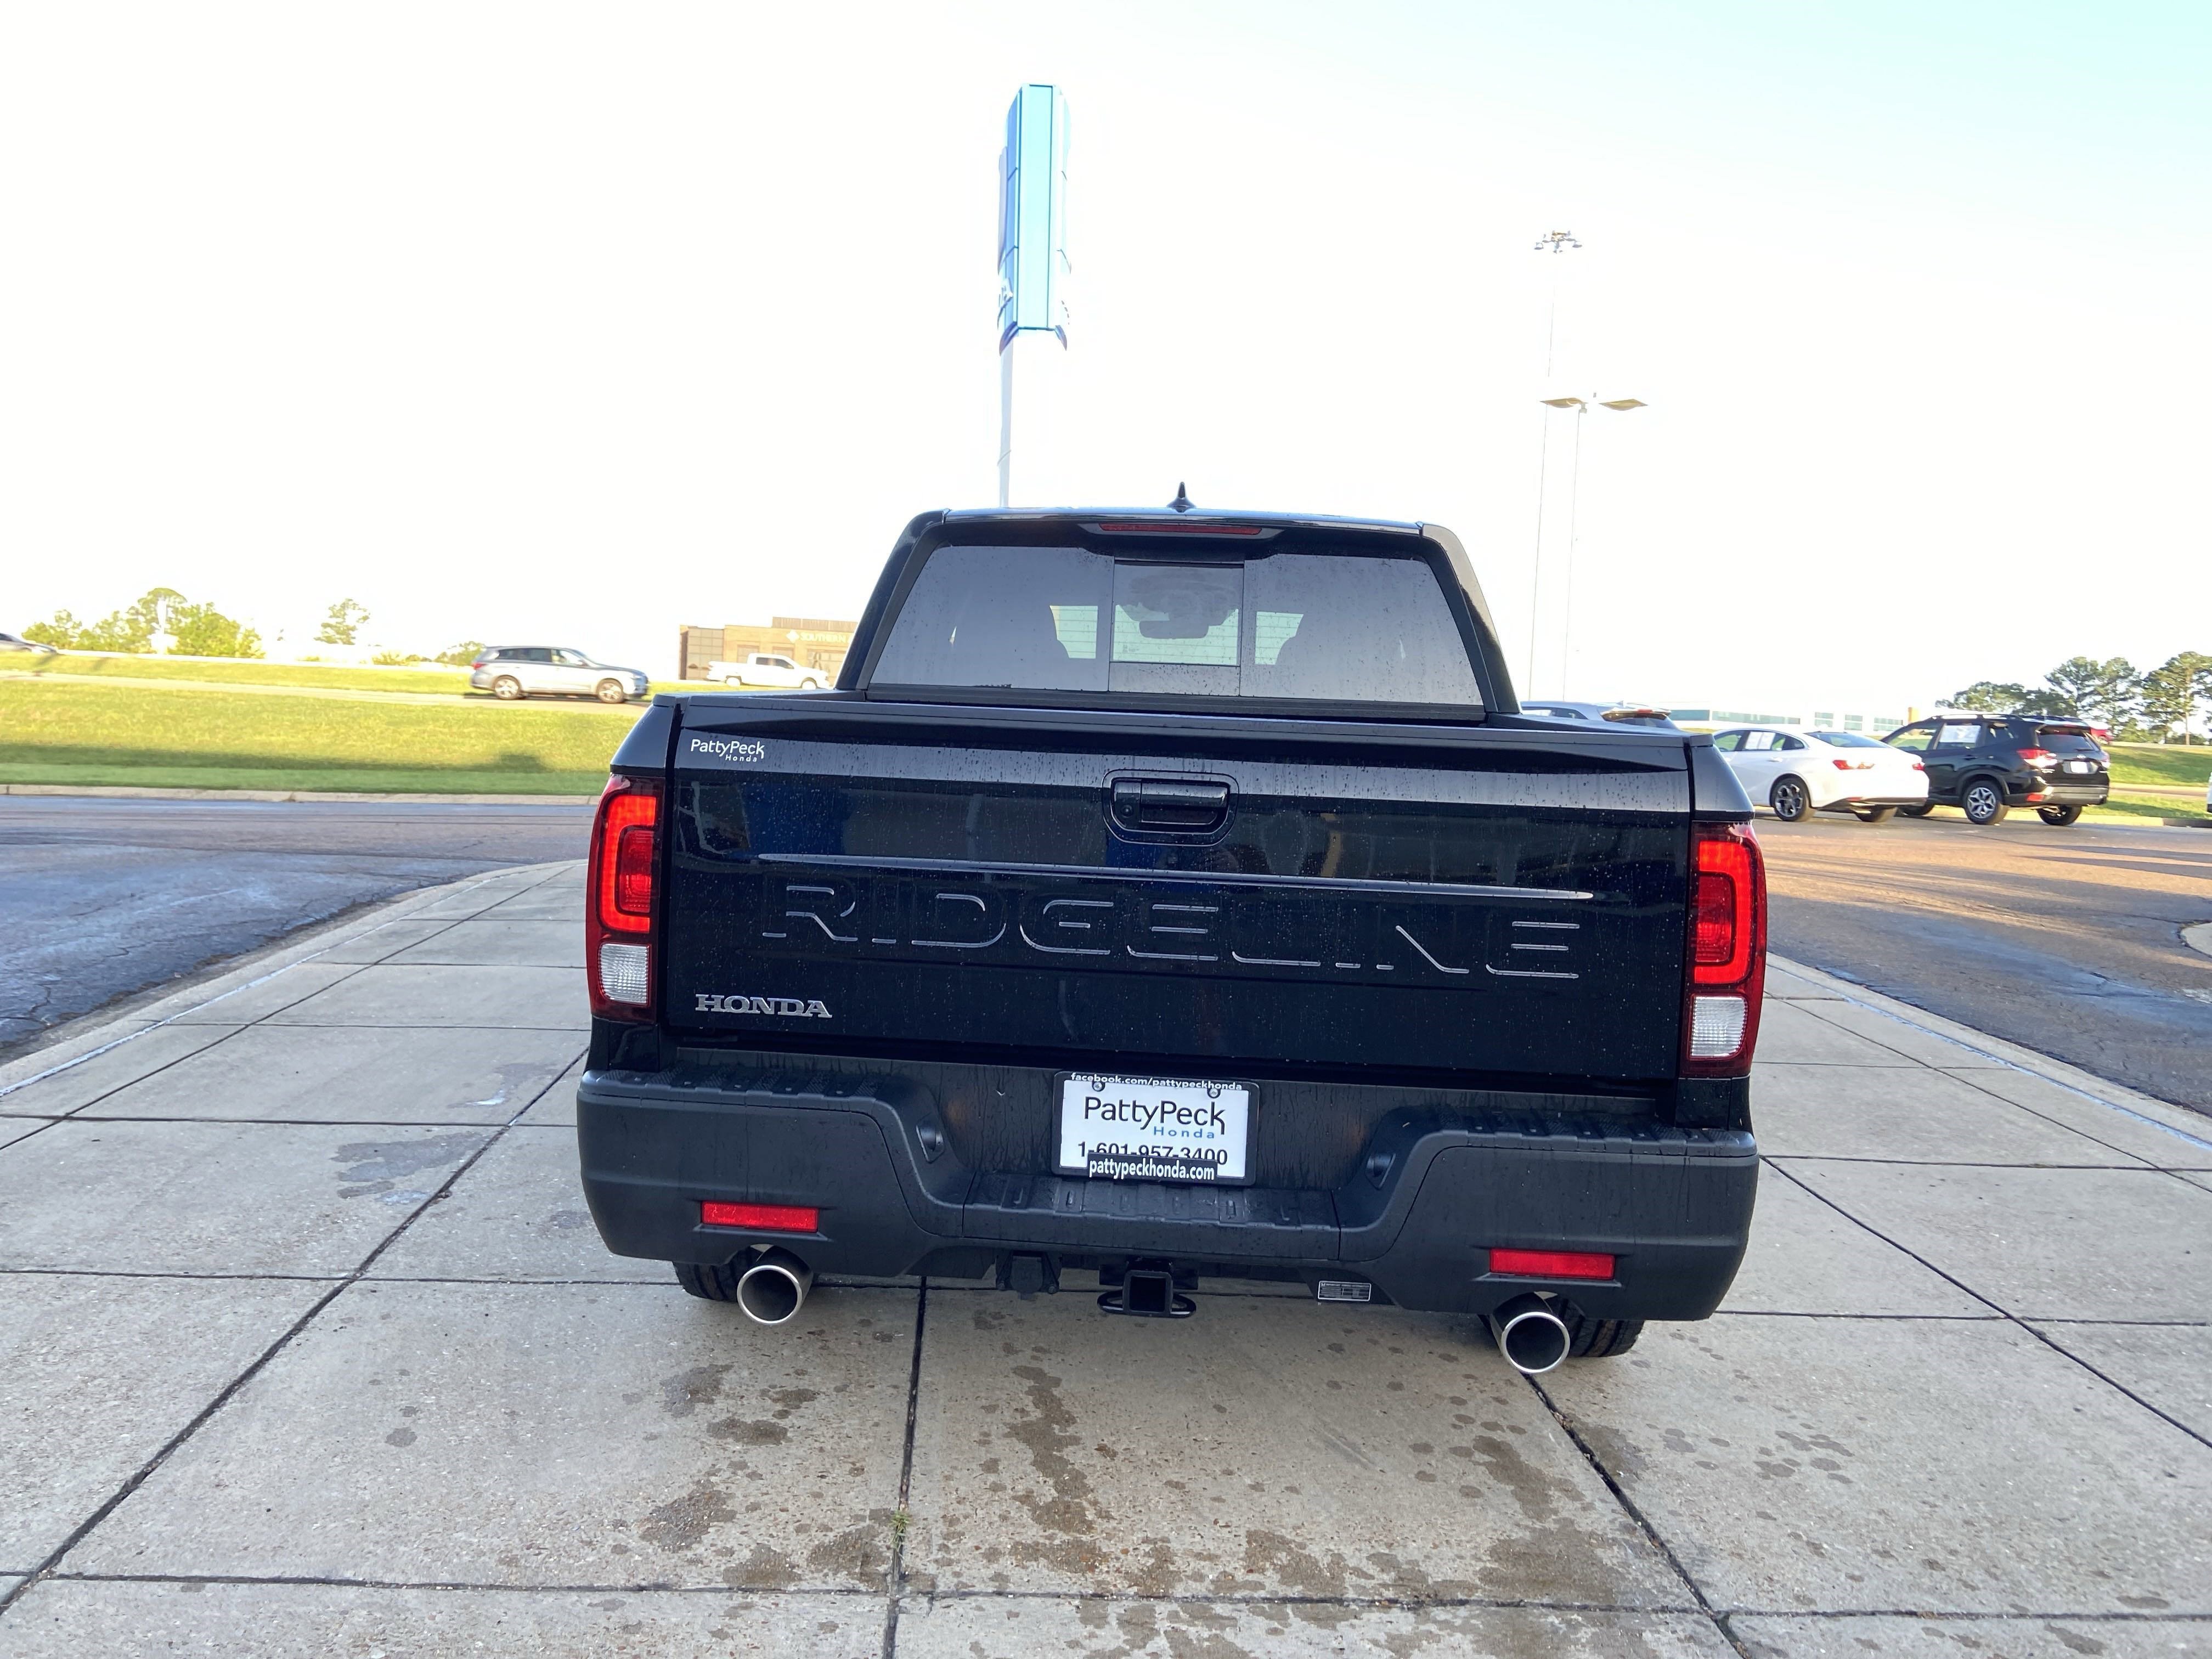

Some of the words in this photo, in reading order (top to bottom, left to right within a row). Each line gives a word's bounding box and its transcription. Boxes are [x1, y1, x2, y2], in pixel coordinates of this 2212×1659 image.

[690, 738, 765, 759] PattyPeck
[725, 754, 758, 763] Honda
[761, 876, 1581, 979] RIDGELINE
[695, 994, 833, 1018] HONDA
[1070, 1072, 1243, 1091] facebook.com/pattypeckhonda
[1084, 1096, 1226, 1135] PattyPeck
[1153, 1126, 1215, 1139] Honda
[1088, 1158, 1215, 1180] pattypeckhonda.com
